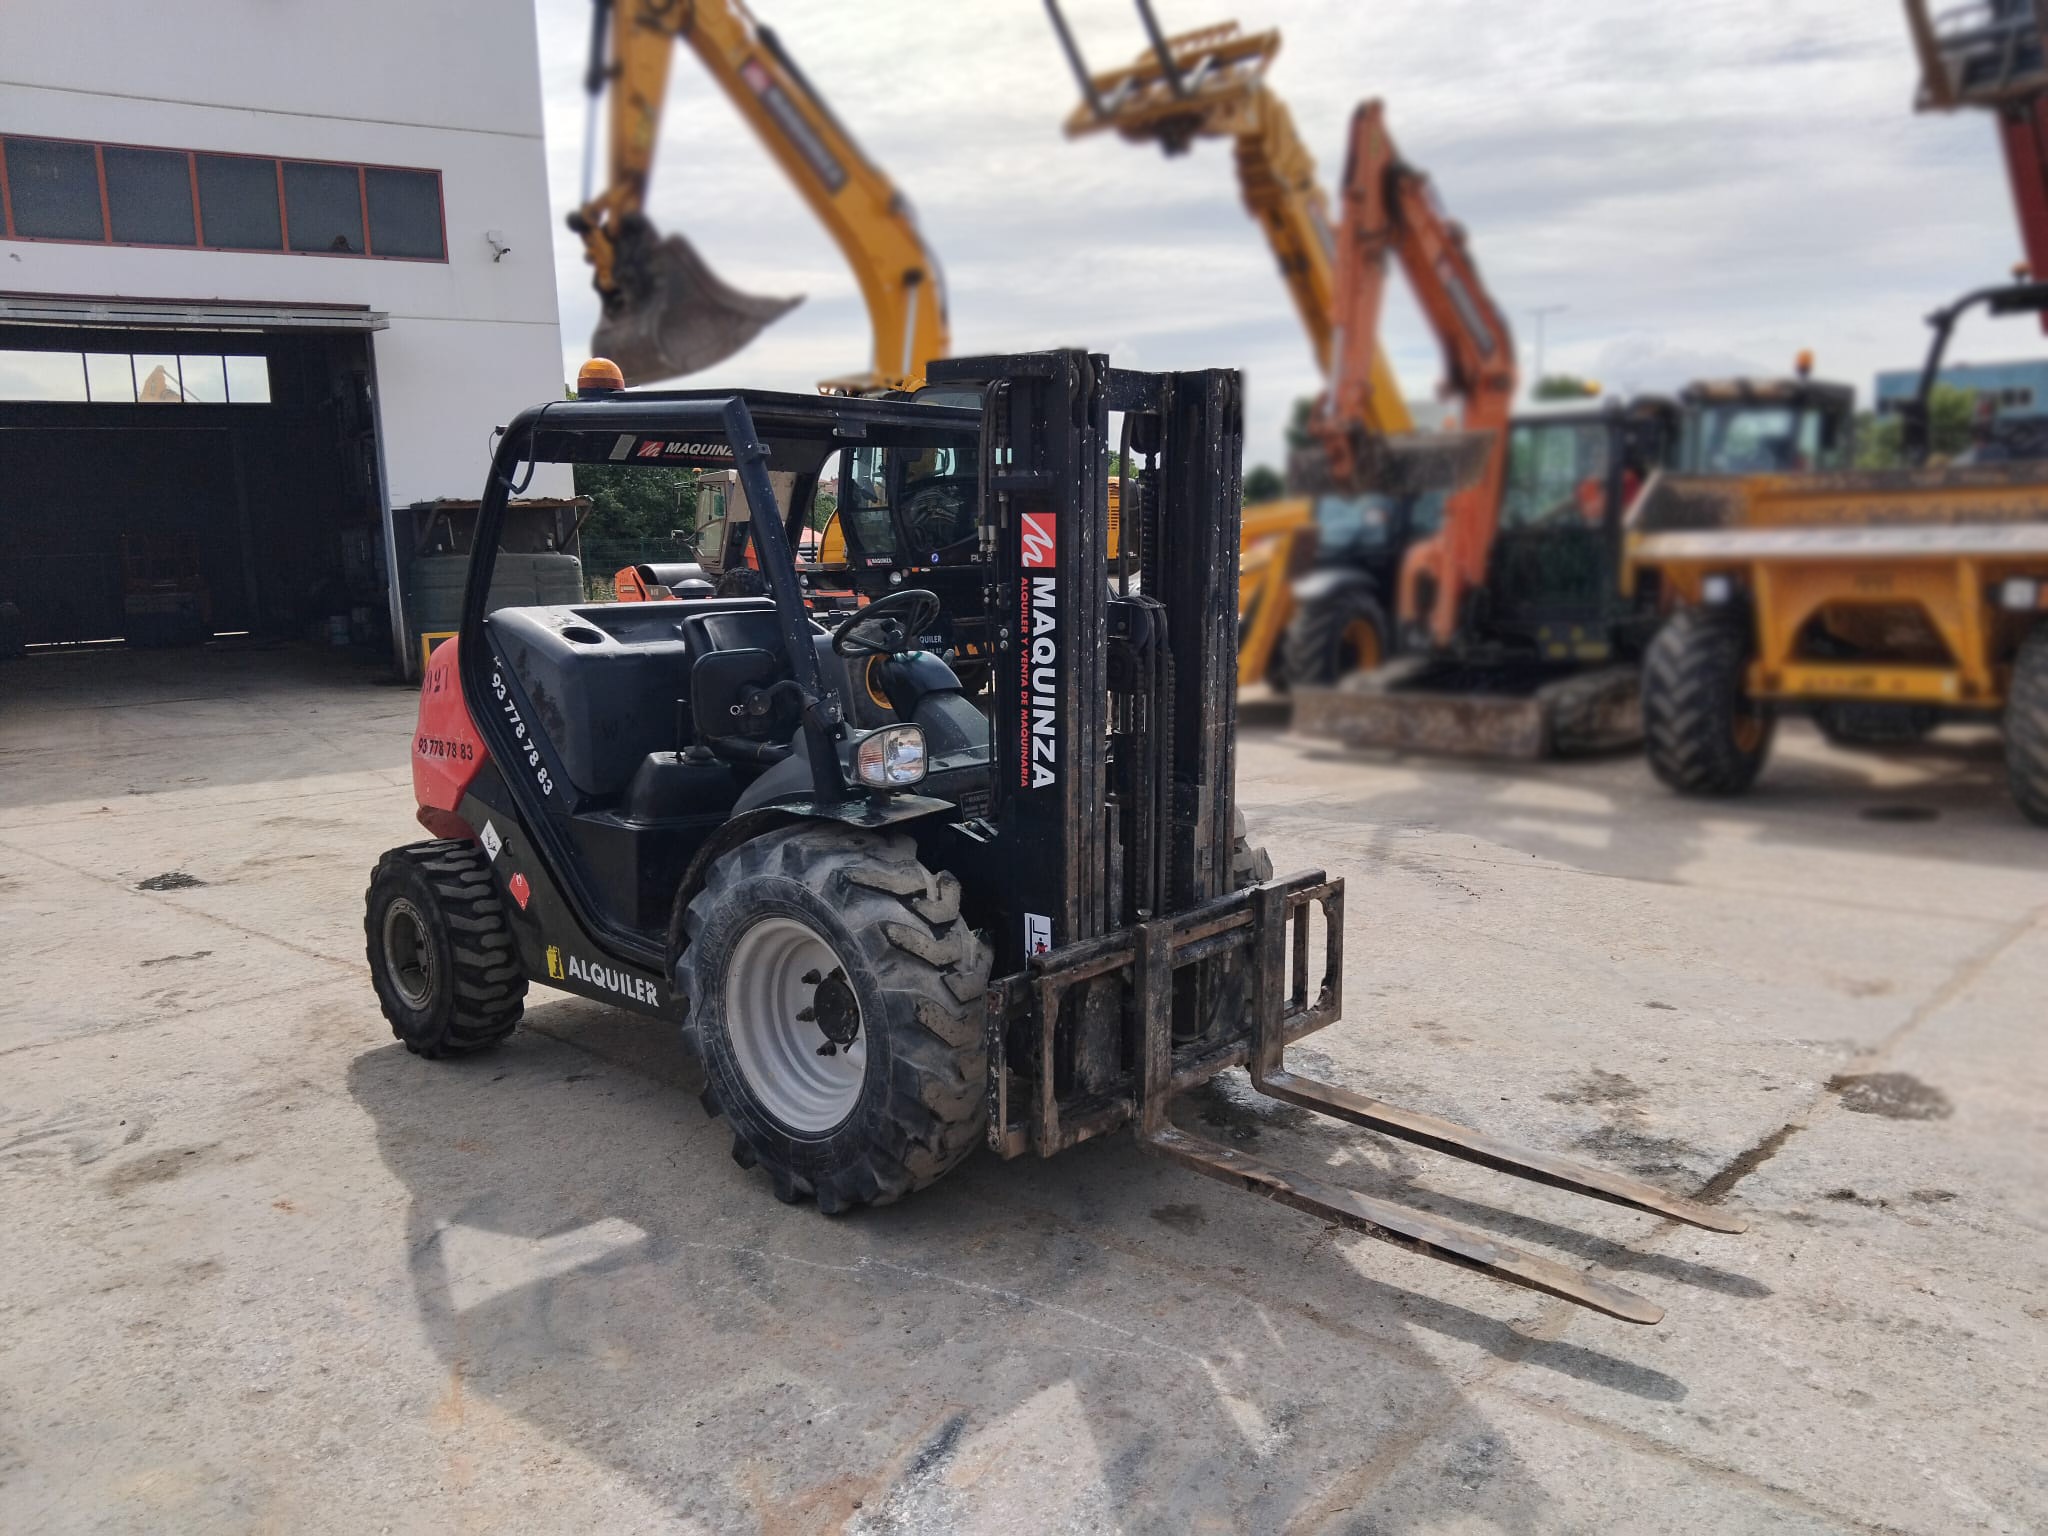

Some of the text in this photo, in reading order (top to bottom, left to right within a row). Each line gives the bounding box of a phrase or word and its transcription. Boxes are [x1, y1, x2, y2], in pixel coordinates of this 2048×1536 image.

[919, 635, 942, 645] QUILER
[1020, 577, 1029, 788] ALQUILER Y VENTA DE MAQUINARIA
[1031, 577, 1056, 789] MAQUINZA
[417, 737, 473, 761] 93 778 78 83
[491, 673, 553, 796] 93 778 78 83
[568, 954, 660, 1008] ALQUILER
